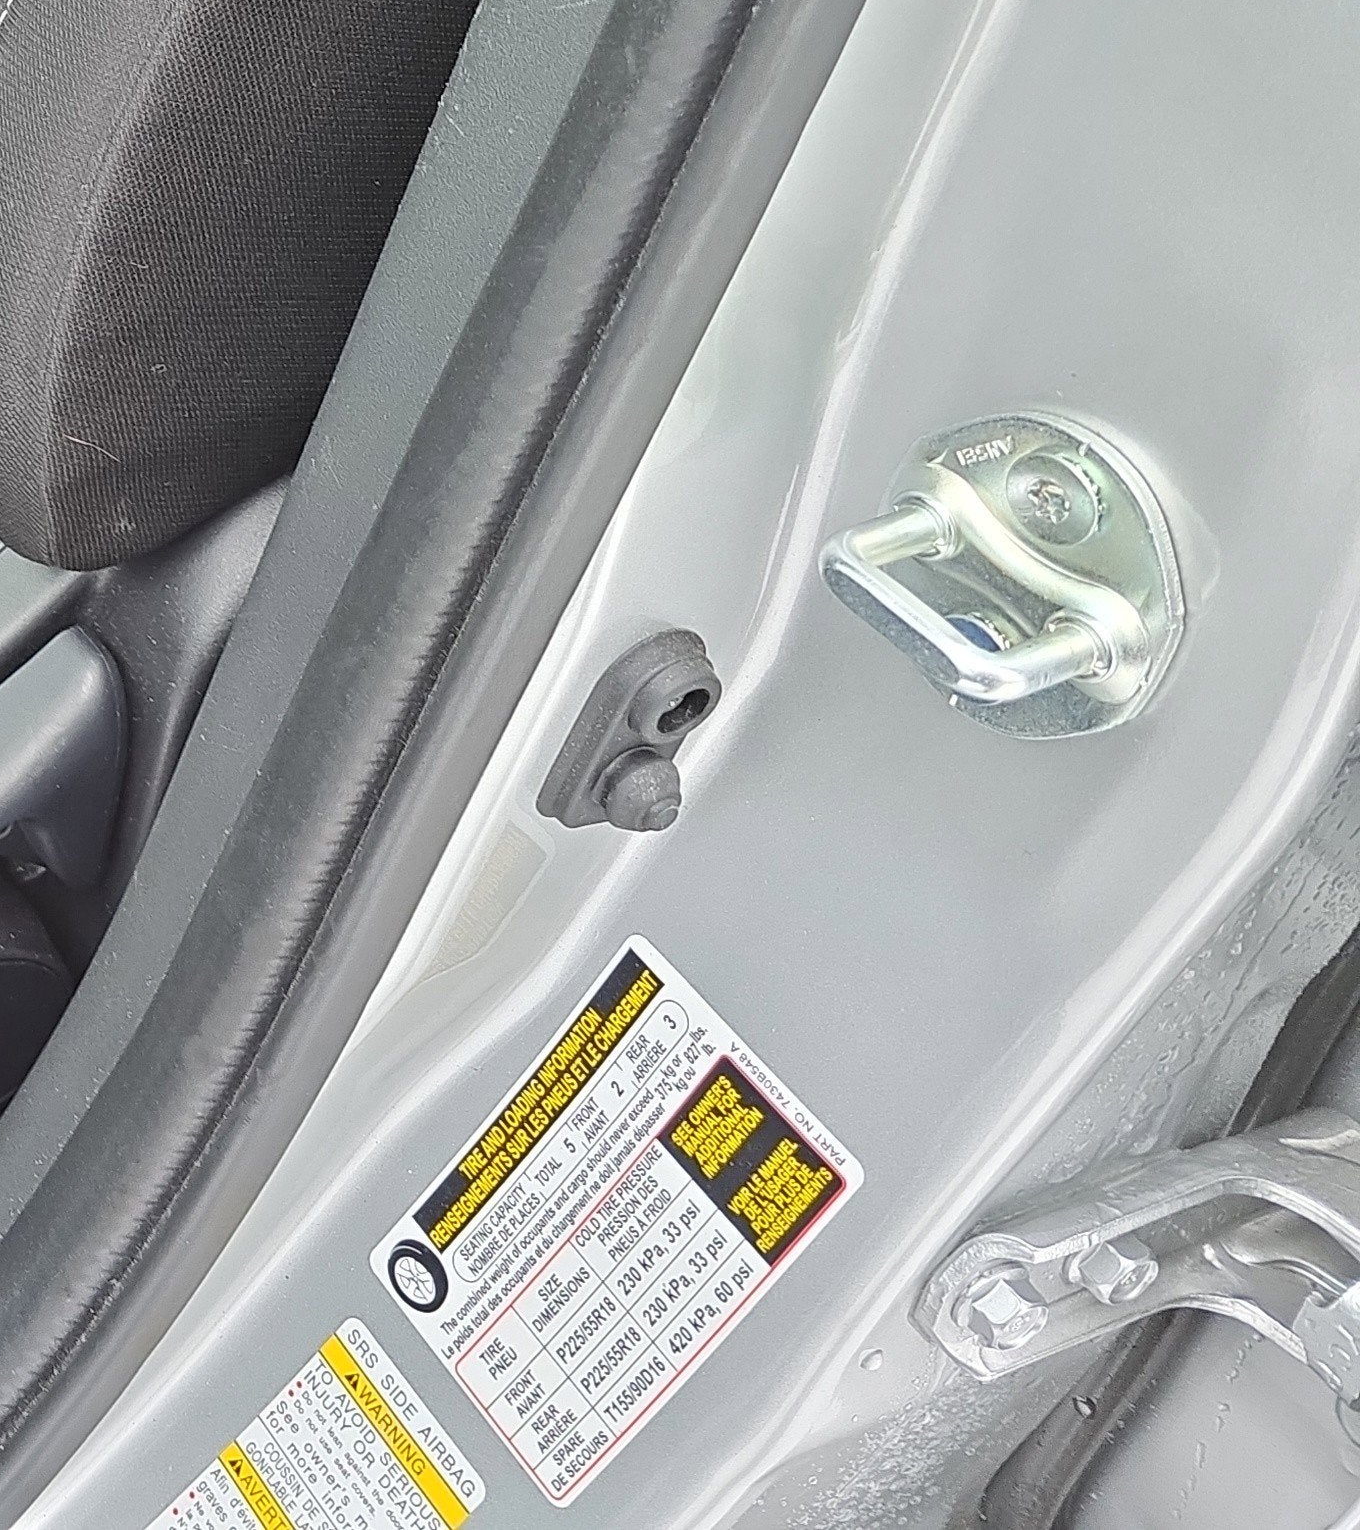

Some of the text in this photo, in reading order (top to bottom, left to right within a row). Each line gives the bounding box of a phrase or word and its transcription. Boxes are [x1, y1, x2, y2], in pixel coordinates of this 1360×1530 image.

[624, 1033, 651, 1064] REAR
[662, 1013, 677, 1030] 3
[682, 1041, 702, 1065] 827
[458, 1006, 603, 1181] TIRE AND LOADING INFORMATION
[609, 1080, 625, 1098] 2
[653, 1077, 674, 1101] 375
[659, 1063, 677, 1081] kg
[671, 1053, 683, 1068] or
[428, 969, 659, 1250] RENSEIGNEMENTS SUR LES PNEUS ET LE CHARGEMENT
[570, 1095, 600, 1131] FRONT
[582, 1109, 610, 1144] AVANT
[608, 1117, 631, 1145] never
[626, 1086, 655, 1122] exceed
[670, 1074, 732, 1147] SEE OWNER'S
[680, 1087, 742, 1158] MANUAL FOR
[693, 1102, 751, 1166] ADDITIONAL
[729, 1040, 847, 1167] PART NO. 7430B548 A
[533, 1136, 577, 1187] TOTAL 5
[585, 1138, 613, 1172] should
[700, 1105, 765, 1180] INFORMATION
[726, 1136, 799, 1216] VOIR LE MANUEL
[440, 1344, 455, 1360] Le
[469, 1304, 491, 1329] total
[486, 1291, 503, 1312] des
[499, 1253, 538, 1298] occupants
[533, 1243, 546, 1259] et
[540, 1234, 555, 1251] du
[550, 1188, 594, 1240] chargement
[588, 1179, 602, 1195] ne
[608, 1137, 638, 1173] jamais
[631, 1101, 667, 1144] dépasser
[671, 1076, 689, 1094] kg
[683, 1065, 697, 1081] ou
[552, 1188, 570, 1211] and
[566, 1168, 590, 1196] cargo
[574, 1144, 663, 1248] COLD TIRE PRESSURE
[596, 1174, 659, 1247] PRESSION DES
[742, 1155, 803, 1221] DE L'USAGER
[750, 1163, 815, 1236] POUR PLUS DE
[755, 1166, 834, 1254] RENSEIGNEMENTS
[459, 1181, 527, 1262] SEATING CAPACITY
[467, 1192, 541, 1277] NOMBRE DE PLACES
[510, 1242, 522, 1259] of
[518, 1205, 557, 1251] occupants
[607, 1187, 672, 1263] PNEUS À FROID
[487, 1252, 516, 1286] weight
[537, 1272, 563, 1303] SIZE
[616, 1265, 643, 1297] 230
[661, 1220, 682, 1244] 33
[641, 1295, 669, 1328] 230
[687, 1250, 709, 1275] 33
[439, 1316, 459, 1336] The
[455, 1277, 492, 1322] combined
[531, 1265, 591, 1334] DIMENSIONS
[555, 1295, 617, 1365] P225/55R18
[667, 1325, 694, 1355] 420
[713, 1279, 735, 1304] 60
[478, 1336, 506, 1367] TIRE
[487, 1345, 518, 1381] PNEU
[579, 1325, 642, 1395] P225/55R18
[302, 1369, 353, 1432] INJURY
[351, 1438, 376, 1469] OR
[313, 1358, 335, 1387] TO
[333, 1392, 377, 1445] AVOID
[346, 1328, 477, 1499] SRS SIDE AIRBAG
[503, 1368, 537, 1407] FRONT
[515, 1382, 547, 1420] AVANT
[530, 1403, 560, 1435] REAR
[602, 1355, 666, 1424] T155/90D16
[264, 1409, 286, 1435] for
[285, 1442, 319, 1485] more
[275, 1399, 301, 1434] See
[302, 1441, 352, 1507] owner's
[292, 1398, 306, 1415] Do
[304, 1416, 319, 1435] not
[317, 1436, 333, 1455] use
[332, 1457, 352, 1480] seat
[300, 1389, 314, 1407] Do
[312, 1408, 328, 1426] not
[342, 1451, 372, 1488] against
[370, 1487, 385, 1506] the
[357, 1384, 427, 1477] WARNING
[550, 1429, 610, 1493] DE SECOURS
[551, 1429, 586, 1467] SPARE
[195, 1480, 229, 1523] graves
[240, 1441, 299, 1514] GONFLABLE
[259, 1441, 308, 1498] COUSSIN
[301, 1497, 321, 1521] DE
